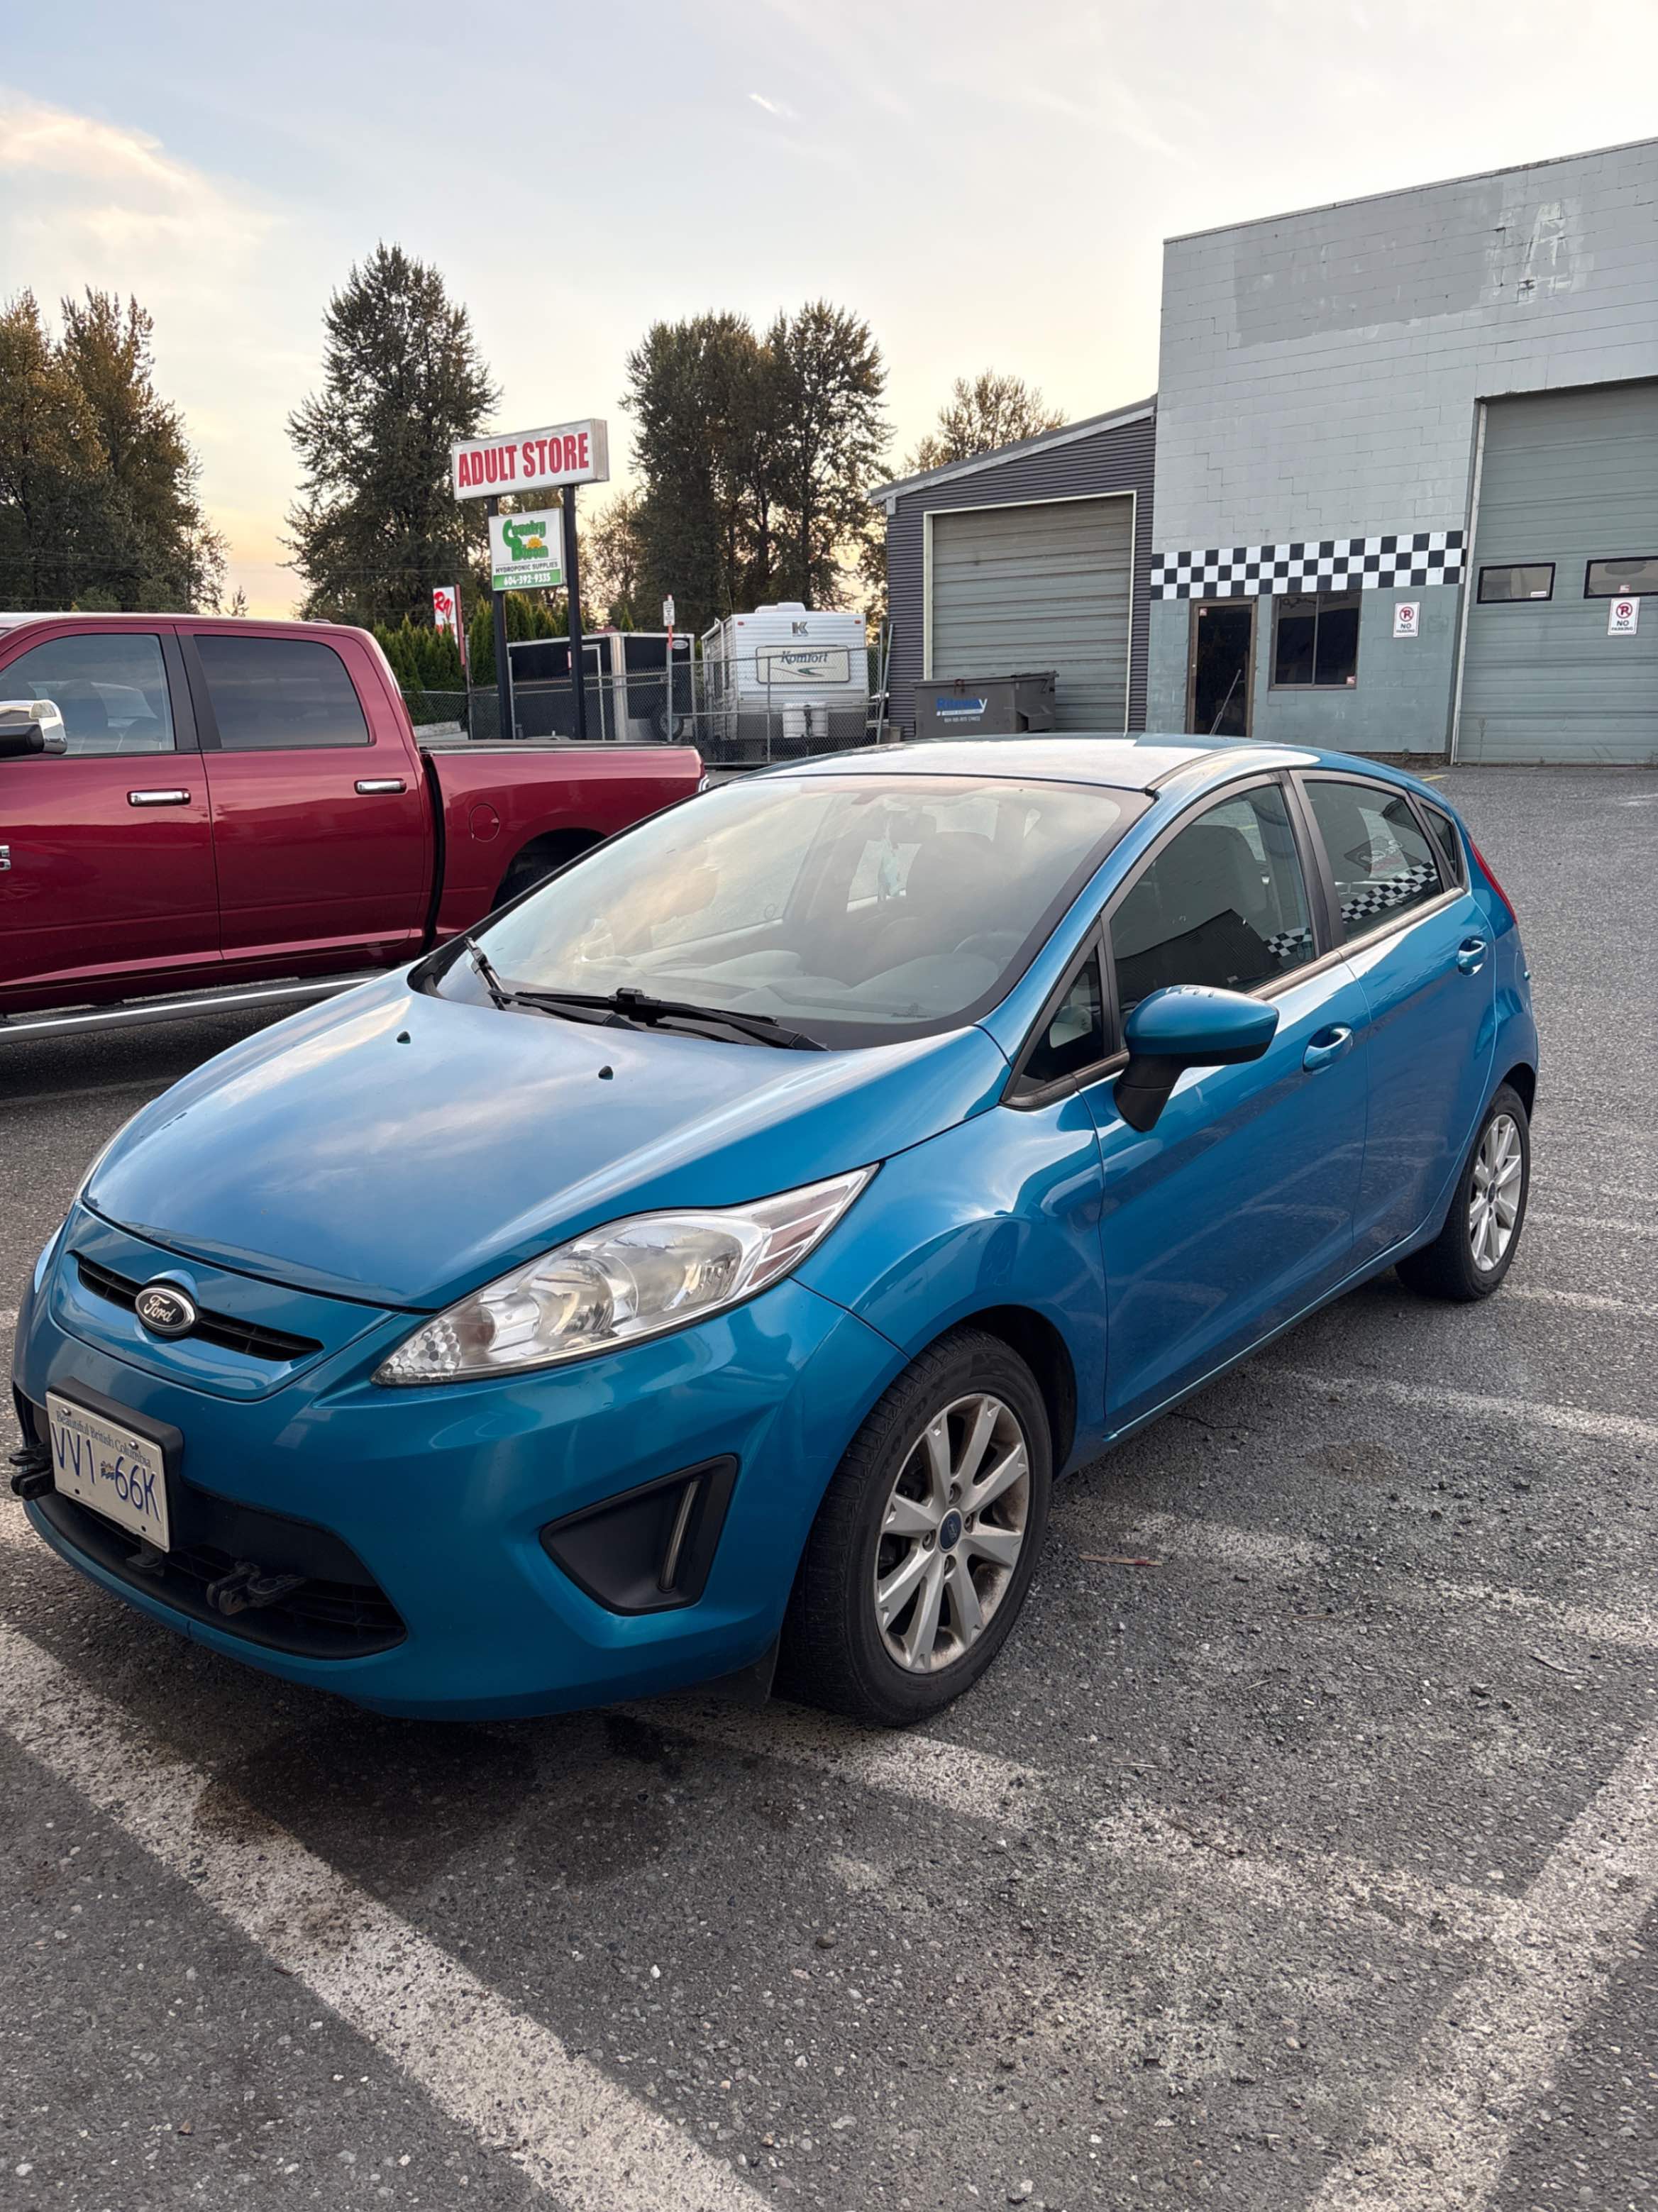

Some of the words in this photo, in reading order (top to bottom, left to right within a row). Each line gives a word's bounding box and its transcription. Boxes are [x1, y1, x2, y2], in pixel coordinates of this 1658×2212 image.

[459, 445, 517, 487] ADULT
[522, 433, 589, 477] STORE
[496, 564, 531, 573] HYDROPONIC
[504, 573, 551, 585] 604-392-9335
[792, 621, 809, 634] K
[781, 651, 828, 664] Komfort
[143, 1295, 177, 1322] Ford
[56, 1410, 89, 1436] Beautiful
[90, 1425, 115, 1449] British
[115, 1439, 151, 1468] Columbia
[51, 1421, 96, 1485] VV1
[115, 1455, 161, 1523] 66K
